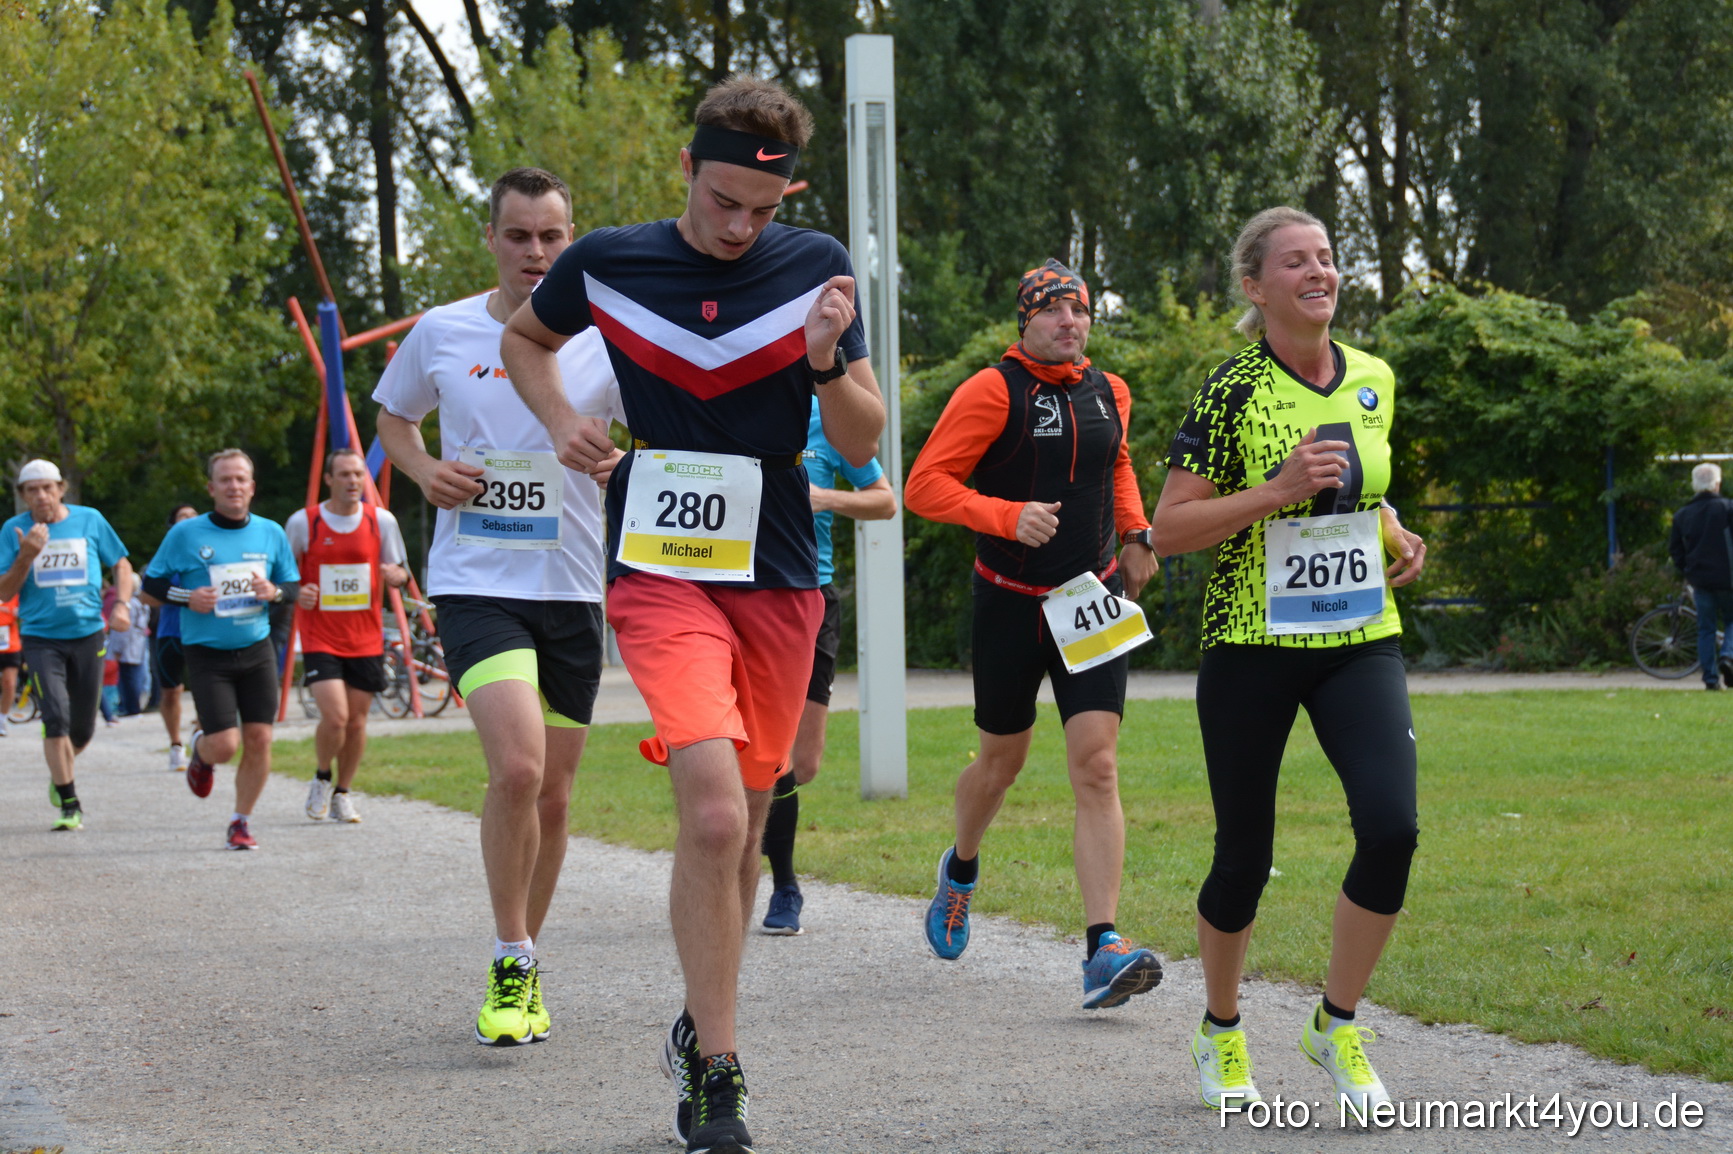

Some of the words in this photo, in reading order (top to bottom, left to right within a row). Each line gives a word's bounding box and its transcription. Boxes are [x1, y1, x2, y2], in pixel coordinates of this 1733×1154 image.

[494, 460, 532, 469] BOCK
[677, 463, 723, 477] BOCK
[472, 478, 545, 511] 2395
[655, 490, 727, 531] 280
[482, 518, 533, 533] Sebastian
[1312, 524, 1350, 537] BOCK
[661, 542, 713, 559] Michael
[42, 553, 79, 569] 2773
[1285, 548, 1368, 589] 2676
[333, 579, 359, 592] 166
[1074, 594, 1121, 631] 410
[1311, 599, 1348, 613] Nicola
